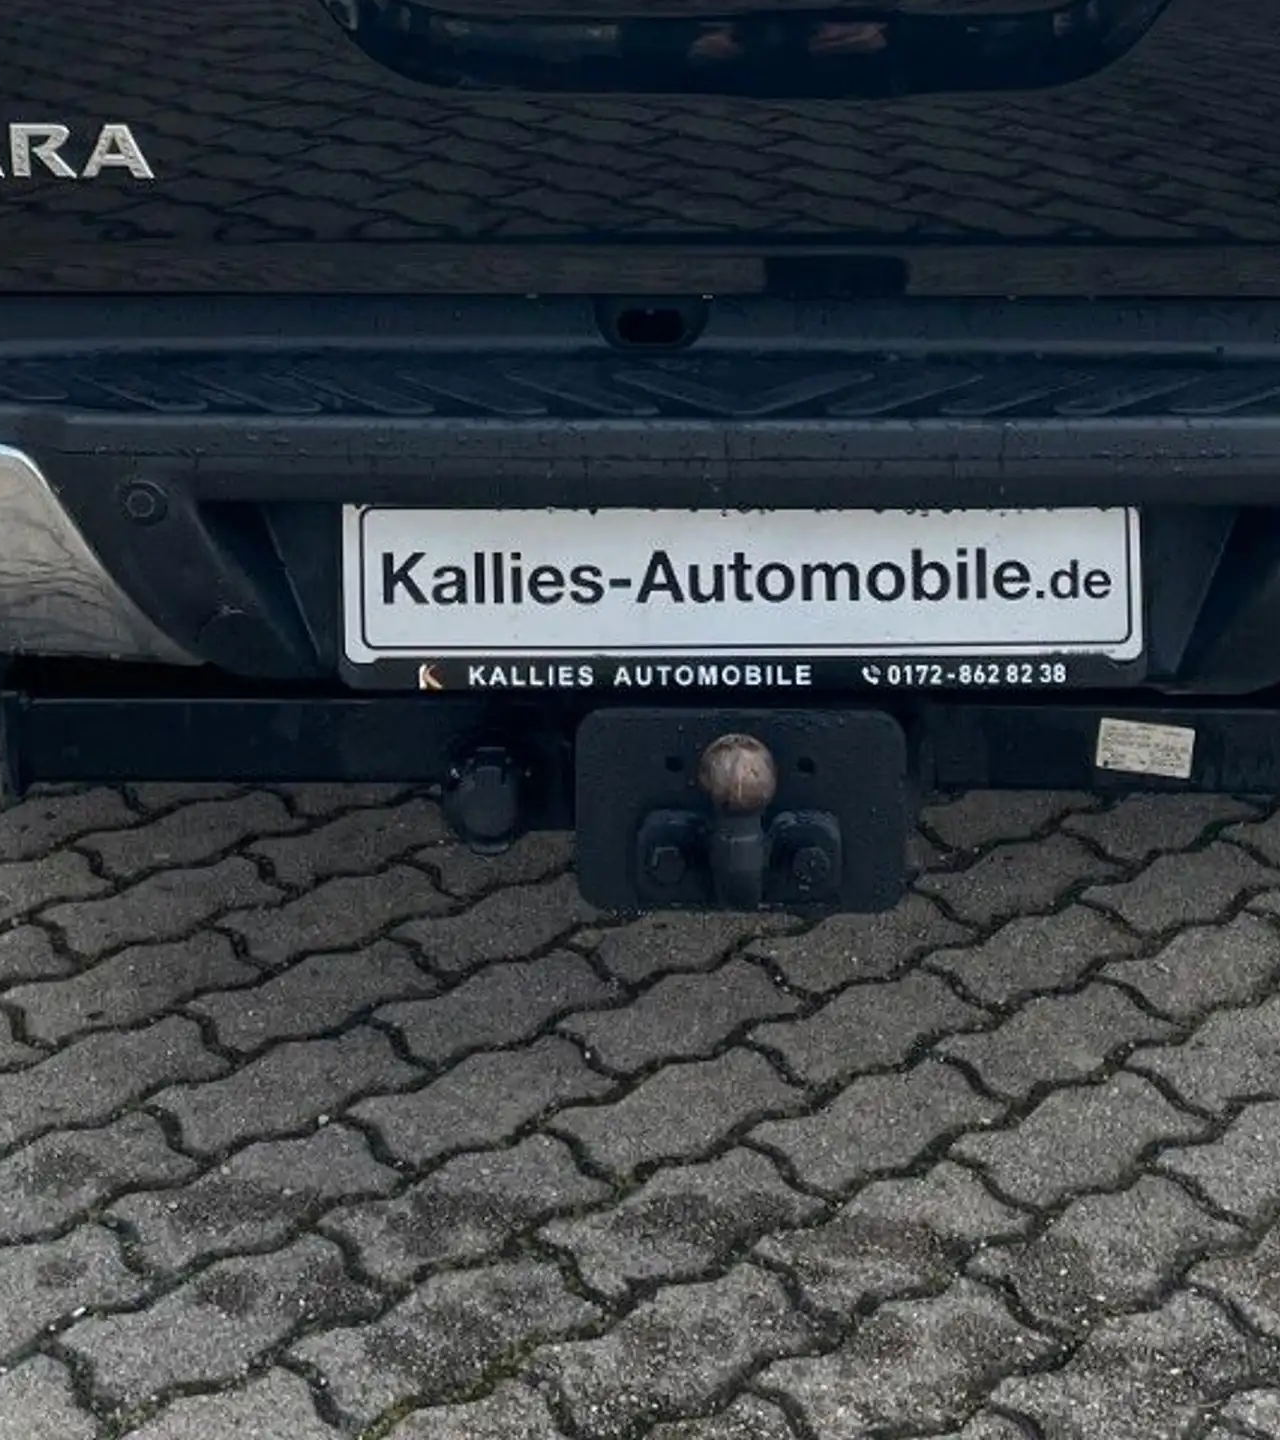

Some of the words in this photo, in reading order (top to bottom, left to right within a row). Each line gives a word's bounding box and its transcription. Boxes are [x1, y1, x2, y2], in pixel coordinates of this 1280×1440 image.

[381, 549, 1112, 605] Kallies-Automobile.de
[469, 664, 594, 687] KALLIES
[614, 664, 813, 687] AUTOMOBILE
[887, 663, 1000, 686] 0172-862
[1005, 663, 1033, 685] 82
[1039, 663, 1067, 685] 38
